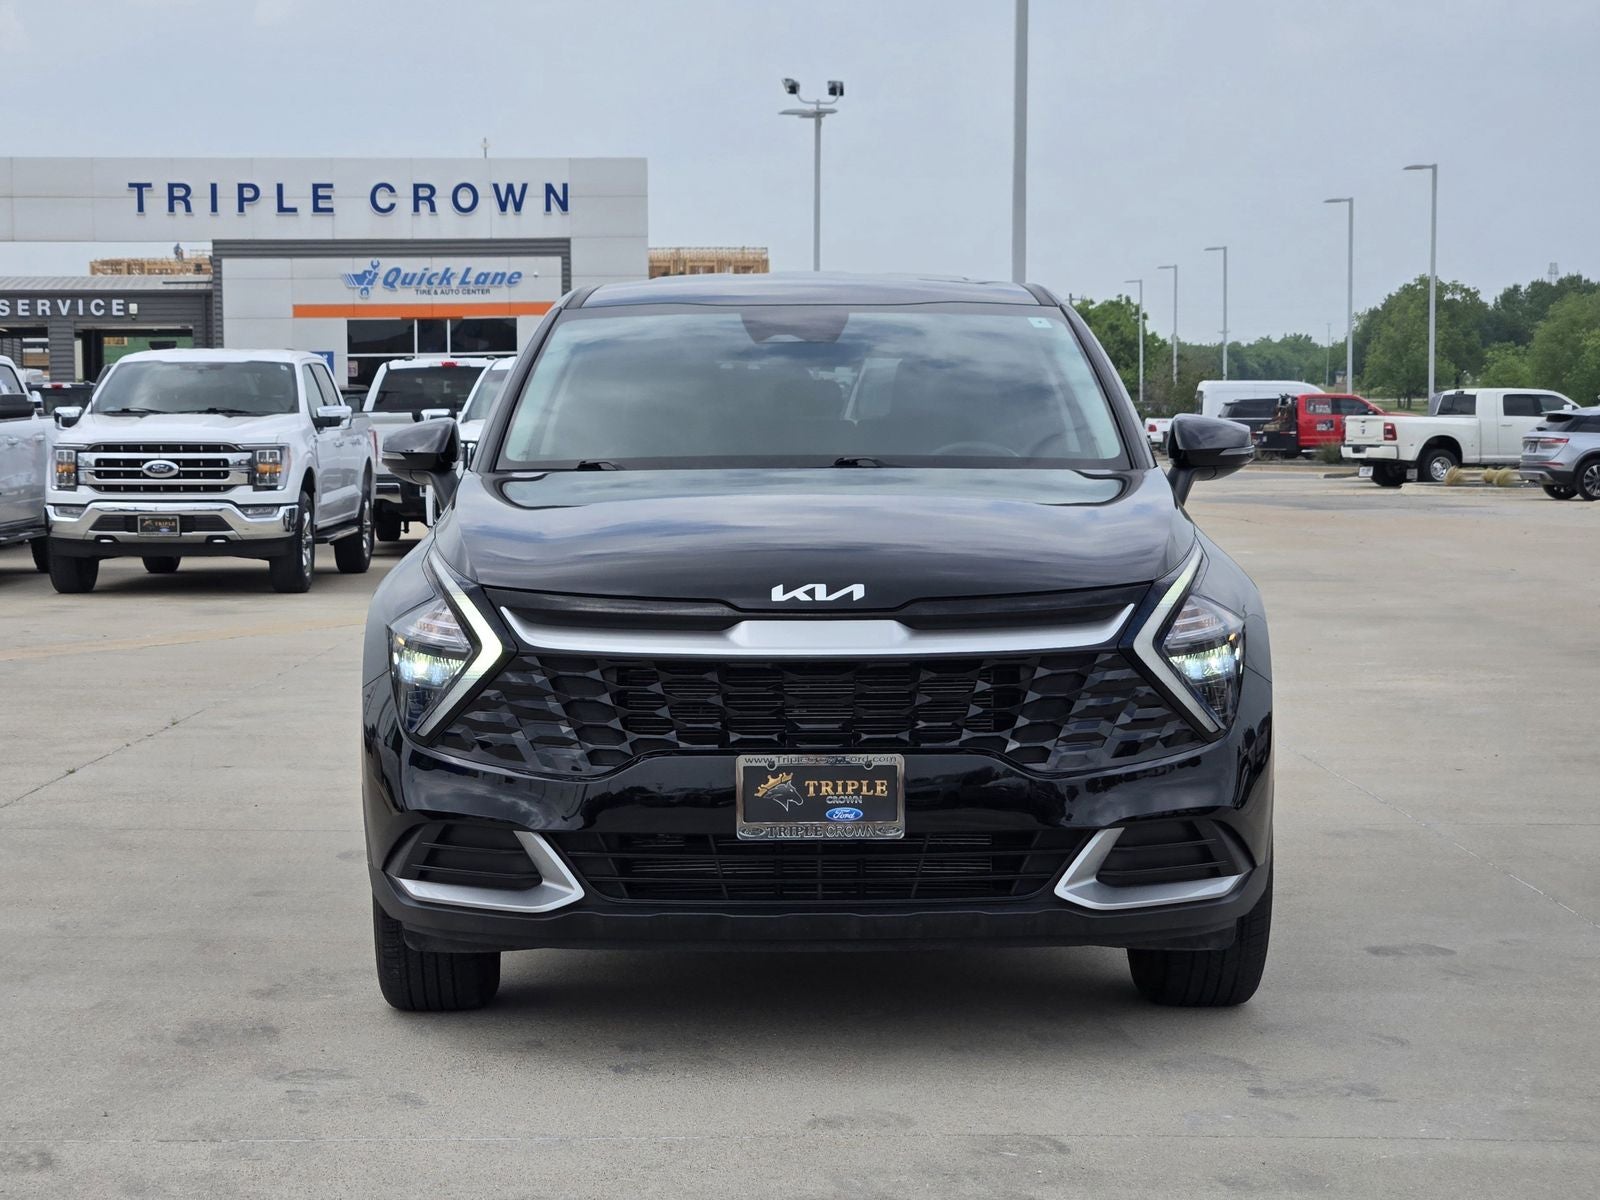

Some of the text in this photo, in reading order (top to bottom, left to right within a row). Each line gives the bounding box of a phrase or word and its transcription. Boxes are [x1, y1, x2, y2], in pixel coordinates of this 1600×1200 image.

[128, 182, 570, 216] TRIPLE CROWN
[382, 267, 523, 292] Quick Lane
[433, 288, 439, 296] &
[440, 288, 460, 296] AUTO
[0, 299, 125, 317] SERVICE
[804, 779, 888, 797] TRIPLE
[825, 795, 863, 804] CROWN
[832, 808, 855, 819] Ford
[765, 825, 824, 838] TRIPLE
[825, 824, 877, 838] CROWN
